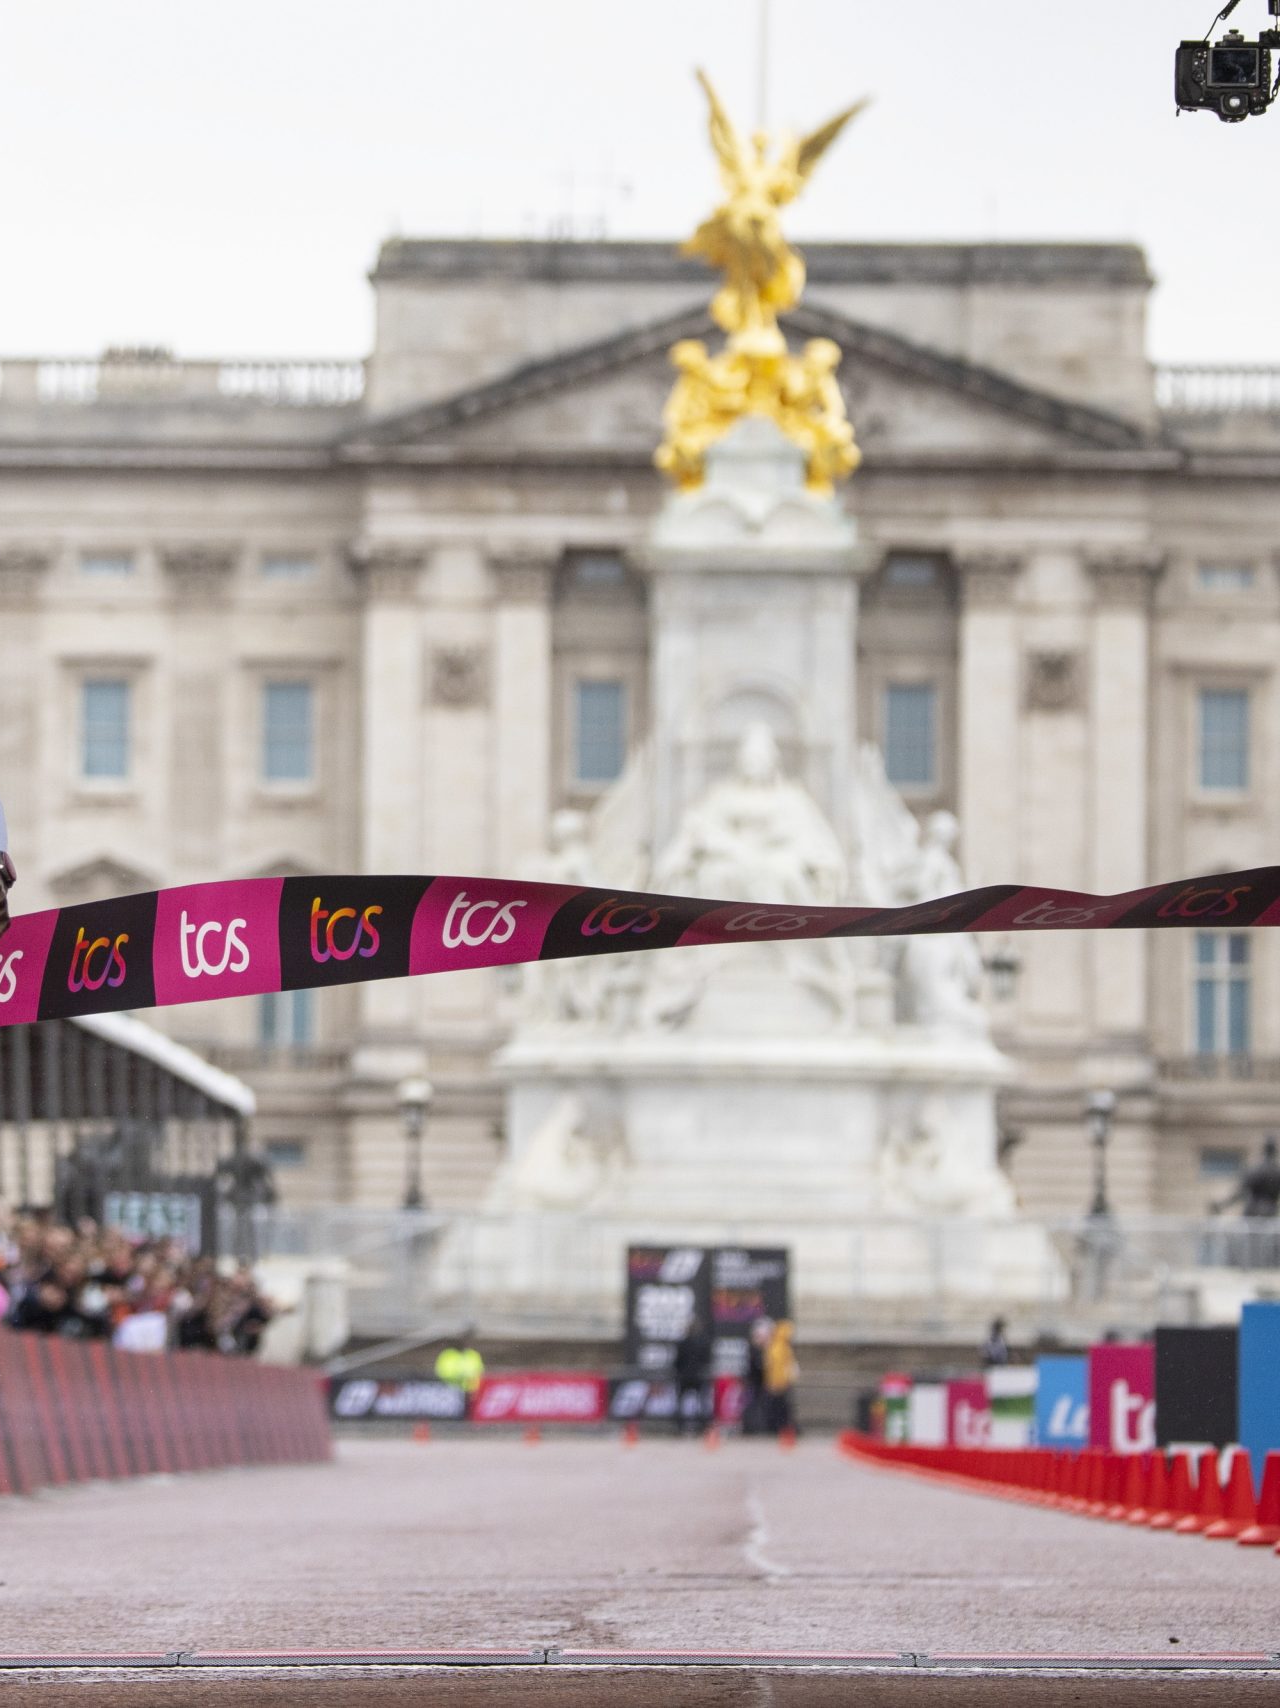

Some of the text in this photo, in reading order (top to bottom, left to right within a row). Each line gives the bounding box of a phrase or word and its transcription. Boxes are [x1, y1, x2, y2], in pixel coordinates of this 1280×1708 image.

[68, 927, 130, 993] tcs
[180, 910, 250, 978] tcs
[310, 897, 383, 963] tcs
[441, 891, 527, 949] tcs
[580, 898, 675, 937] tcs
[724, 908, 825, 932] tcs
[1012, 899, 1113, 926] tcs
[1156, 883, 1252, 919] tcs
